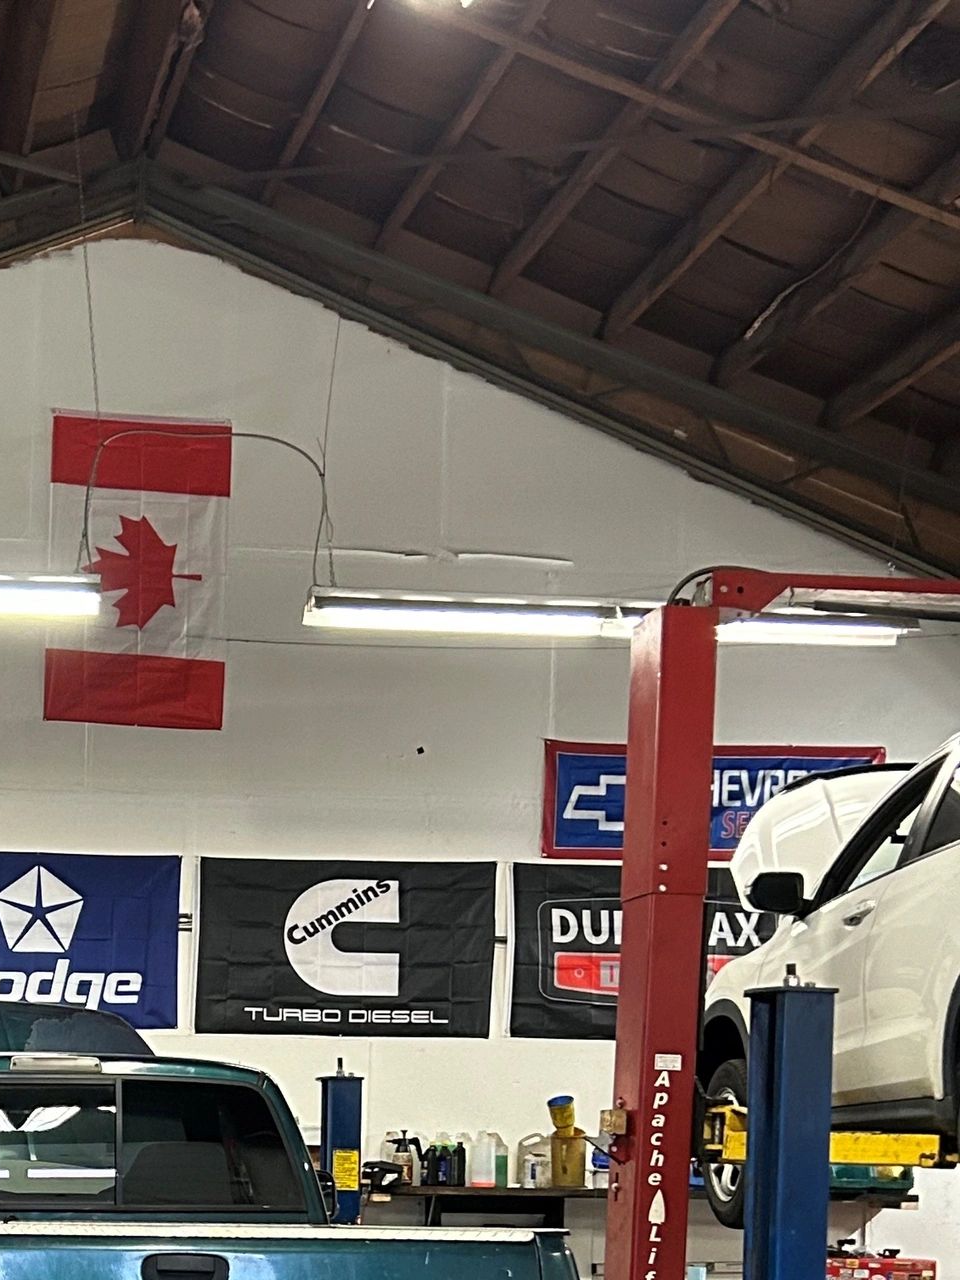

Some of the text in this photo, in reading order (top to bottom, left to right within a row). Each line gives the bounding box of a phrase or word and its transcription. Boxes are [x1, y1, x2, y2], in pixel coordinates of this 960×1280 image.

[286, 879, 391, 945] Cummins
[551, 908, 763, 947] DUAX
[244, 1007, 449, 1024] TURBO DIESEL
[647, 1070, 671, 1187] Apache
